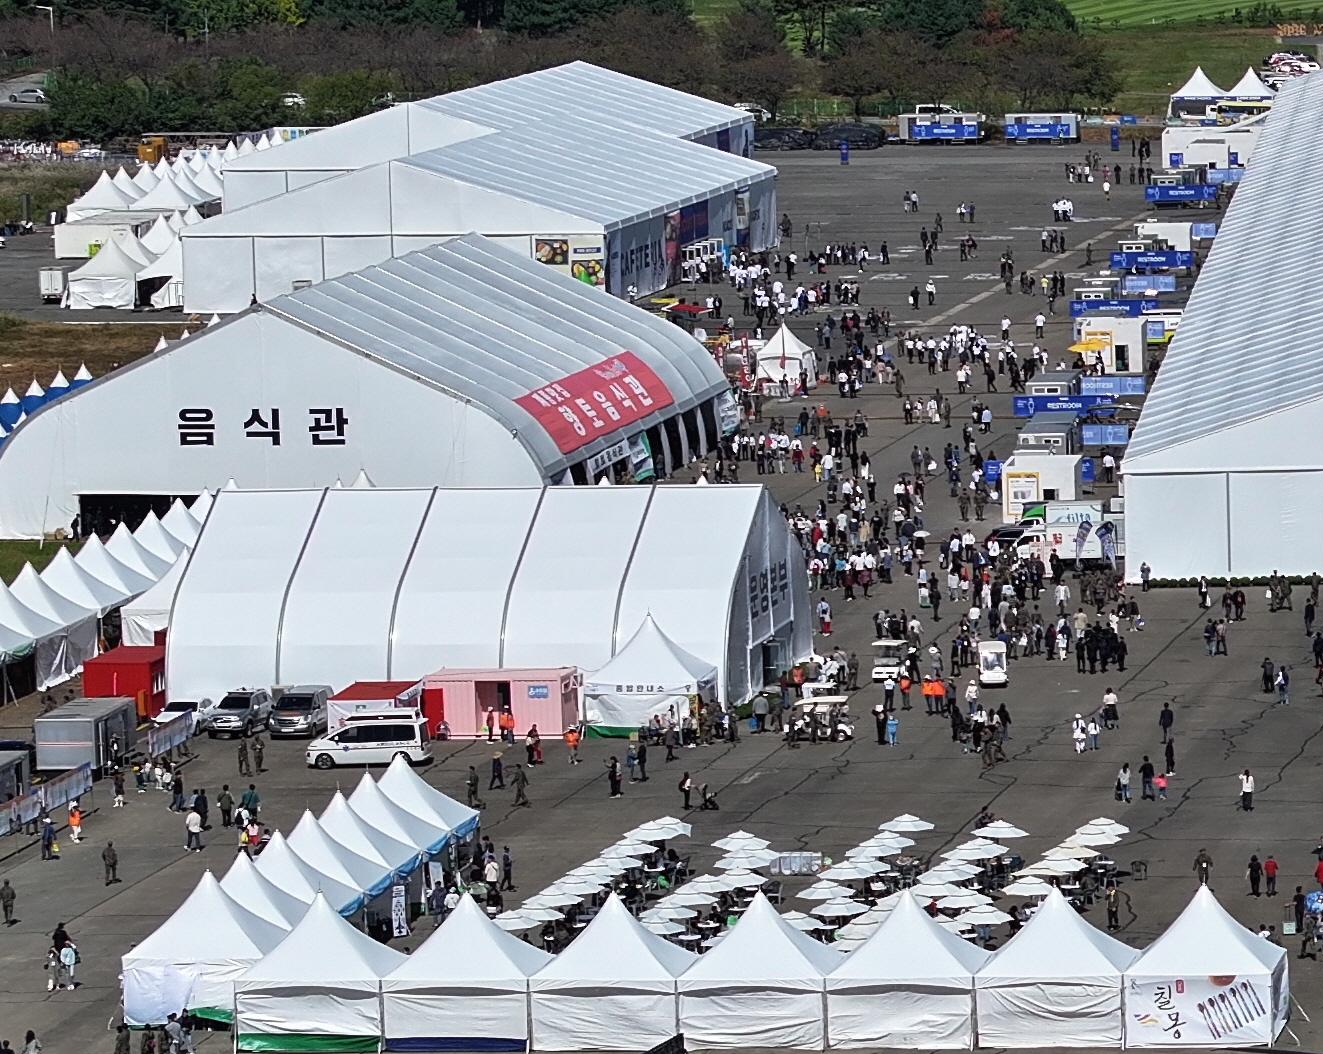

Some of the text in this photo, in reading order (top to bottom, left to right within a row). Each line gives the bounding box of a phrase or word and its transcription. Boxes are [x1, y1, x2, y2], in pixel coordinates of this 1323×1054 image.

[177, 407, 349, 446] 음식관
[557, 374, 653, 437] 향토음식관
[750, 558, 788, 619] 운영본부
[615, 684, 665, 693] 종합안내소
